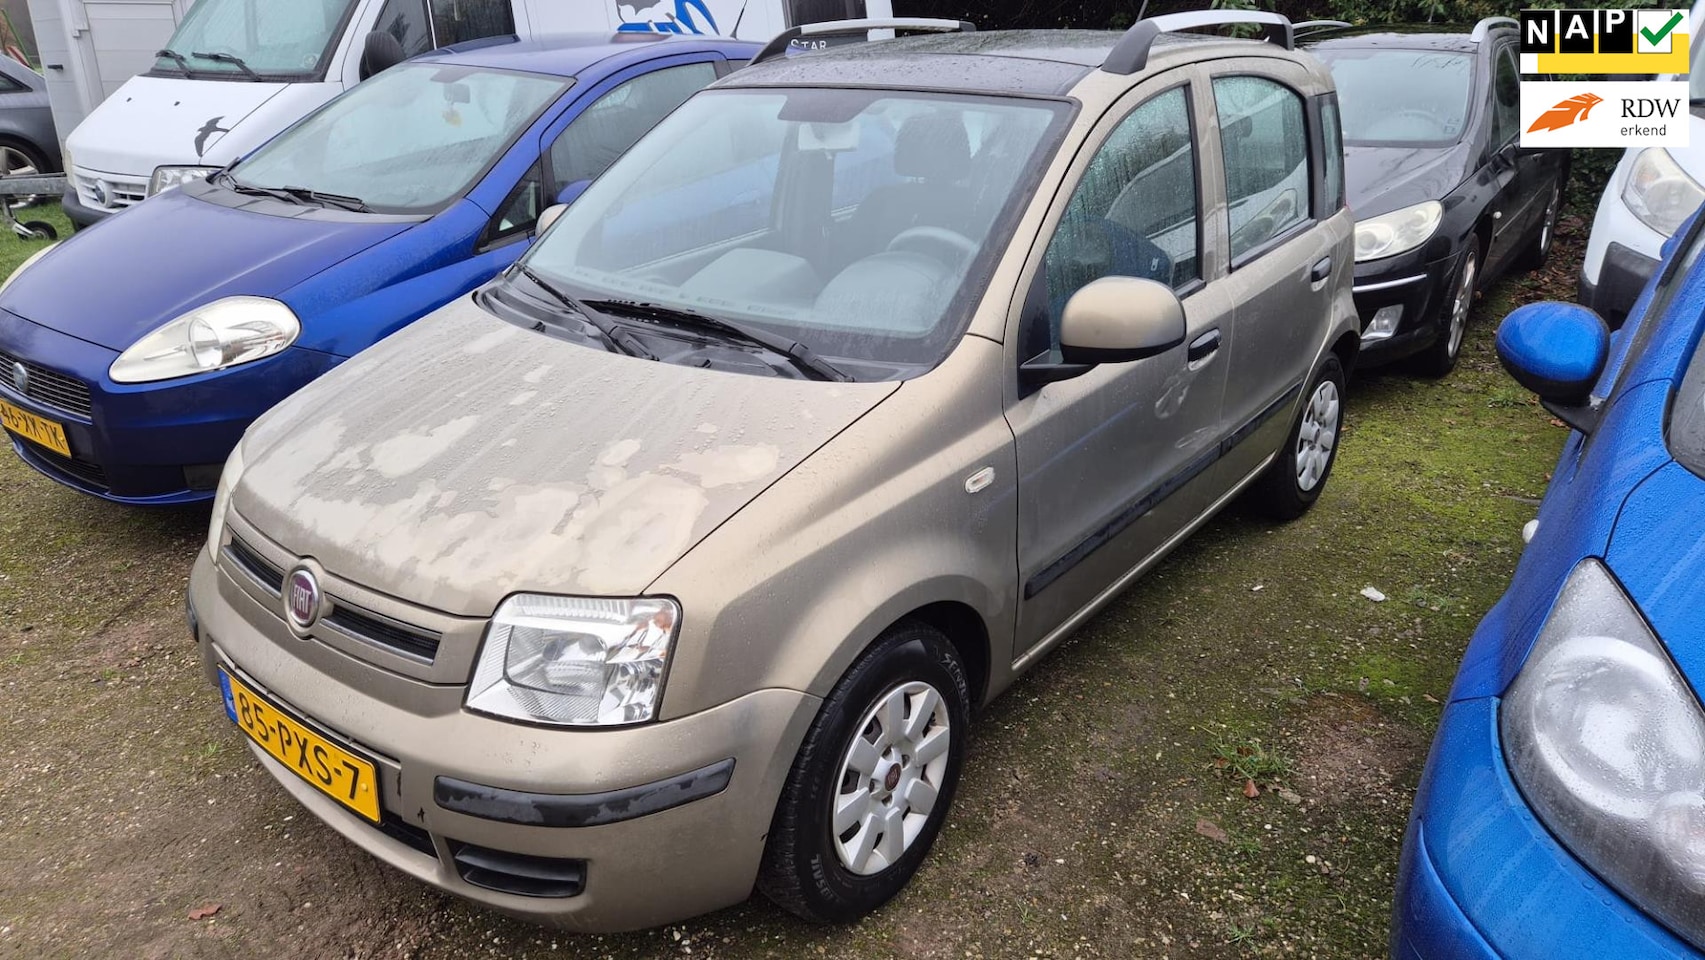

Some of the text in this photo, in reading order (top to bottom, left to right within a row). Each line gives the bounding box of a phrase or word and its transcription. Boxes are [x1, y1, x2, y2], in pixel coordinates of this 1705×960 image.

[790, 38, 827, 50] STAR
[293, 583, 312, 614] FIAT
[238, 692, 360, 800] 85-PXS-7
